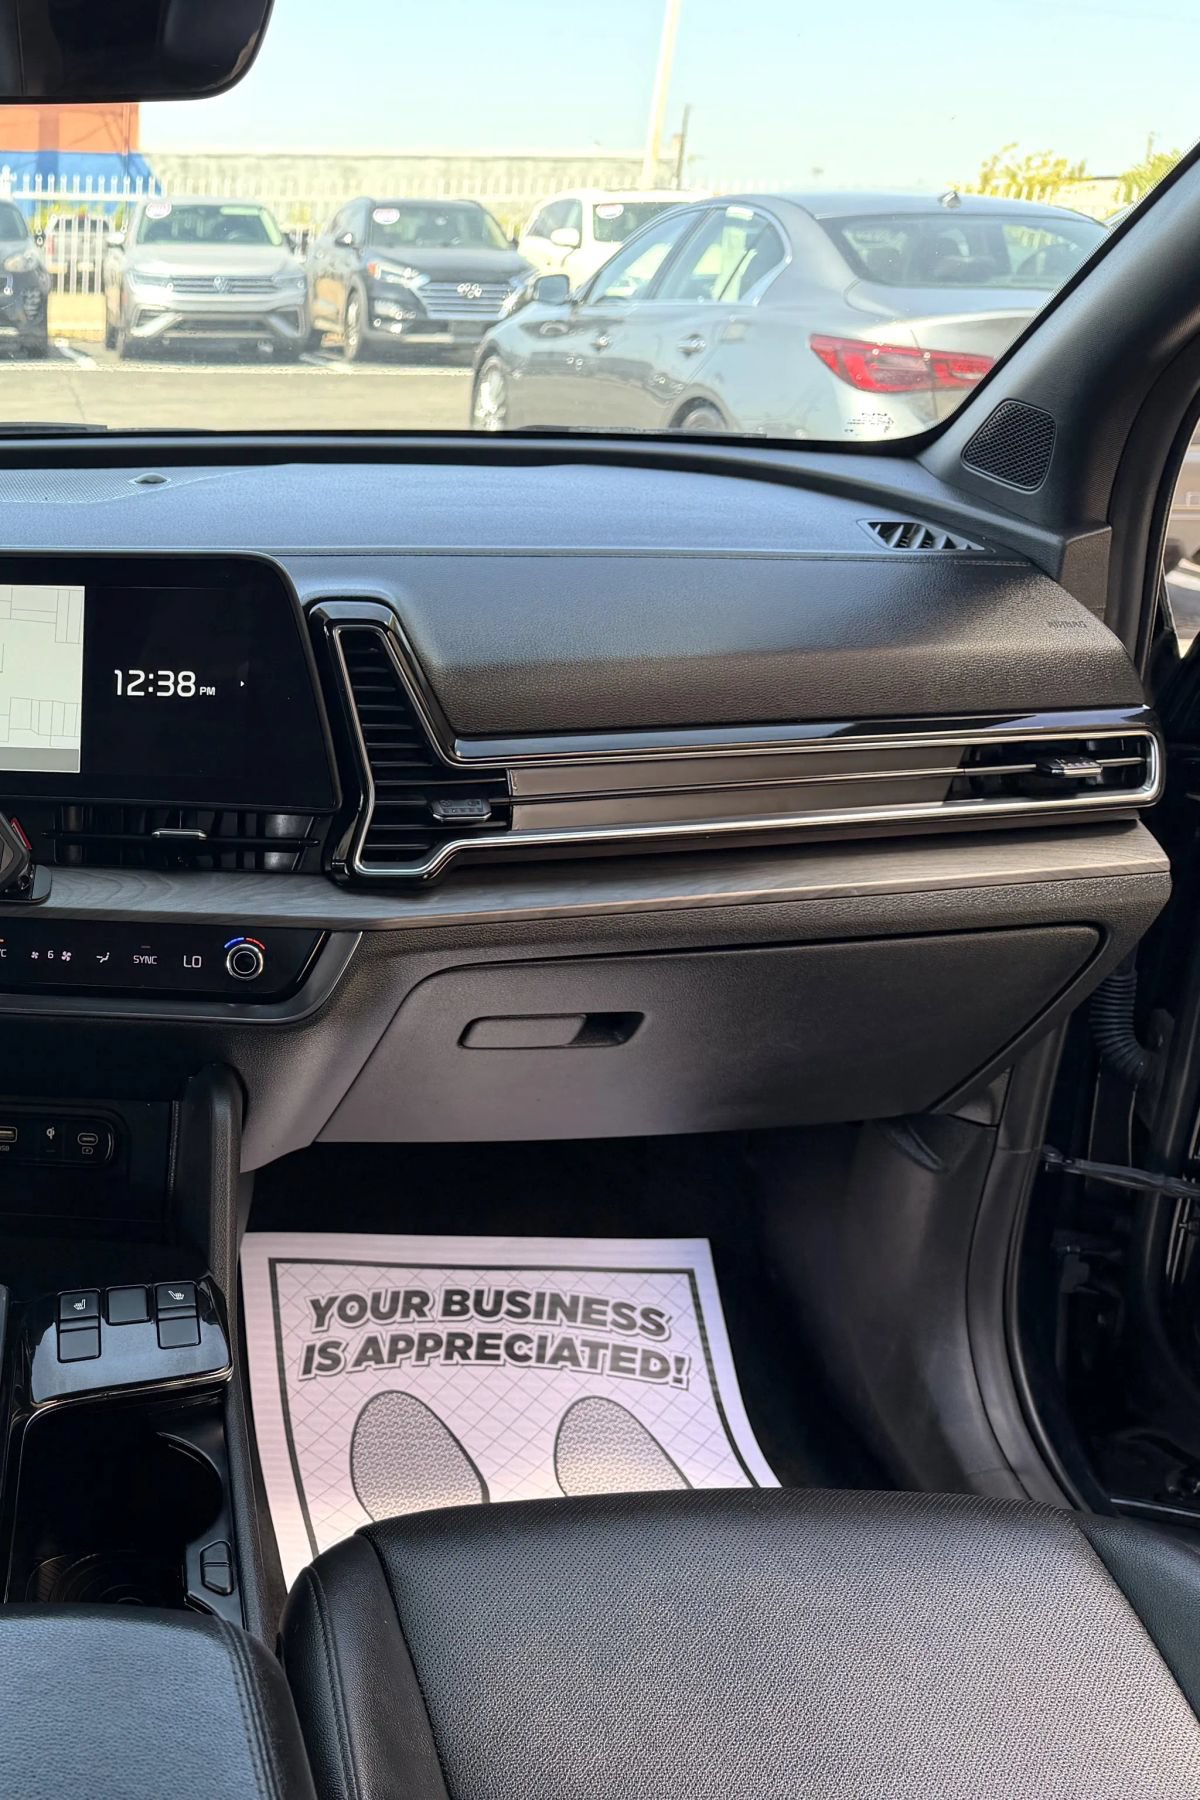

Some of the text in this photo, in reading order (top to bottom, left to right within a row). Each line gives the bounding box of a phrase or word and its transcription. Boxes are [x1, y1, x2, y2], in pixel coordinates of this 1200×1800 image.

[114, 669, 216, 697] 12:38 PM
[47, 951, 54, 959] 6
[133, 955, 158, 965] SYNC
[183, 956, 202, 968] LO
[308, 1288, 668, 1338] YOUR BUSINESS
[301, 1331, 689, 1386] IS APPRECIATED!
